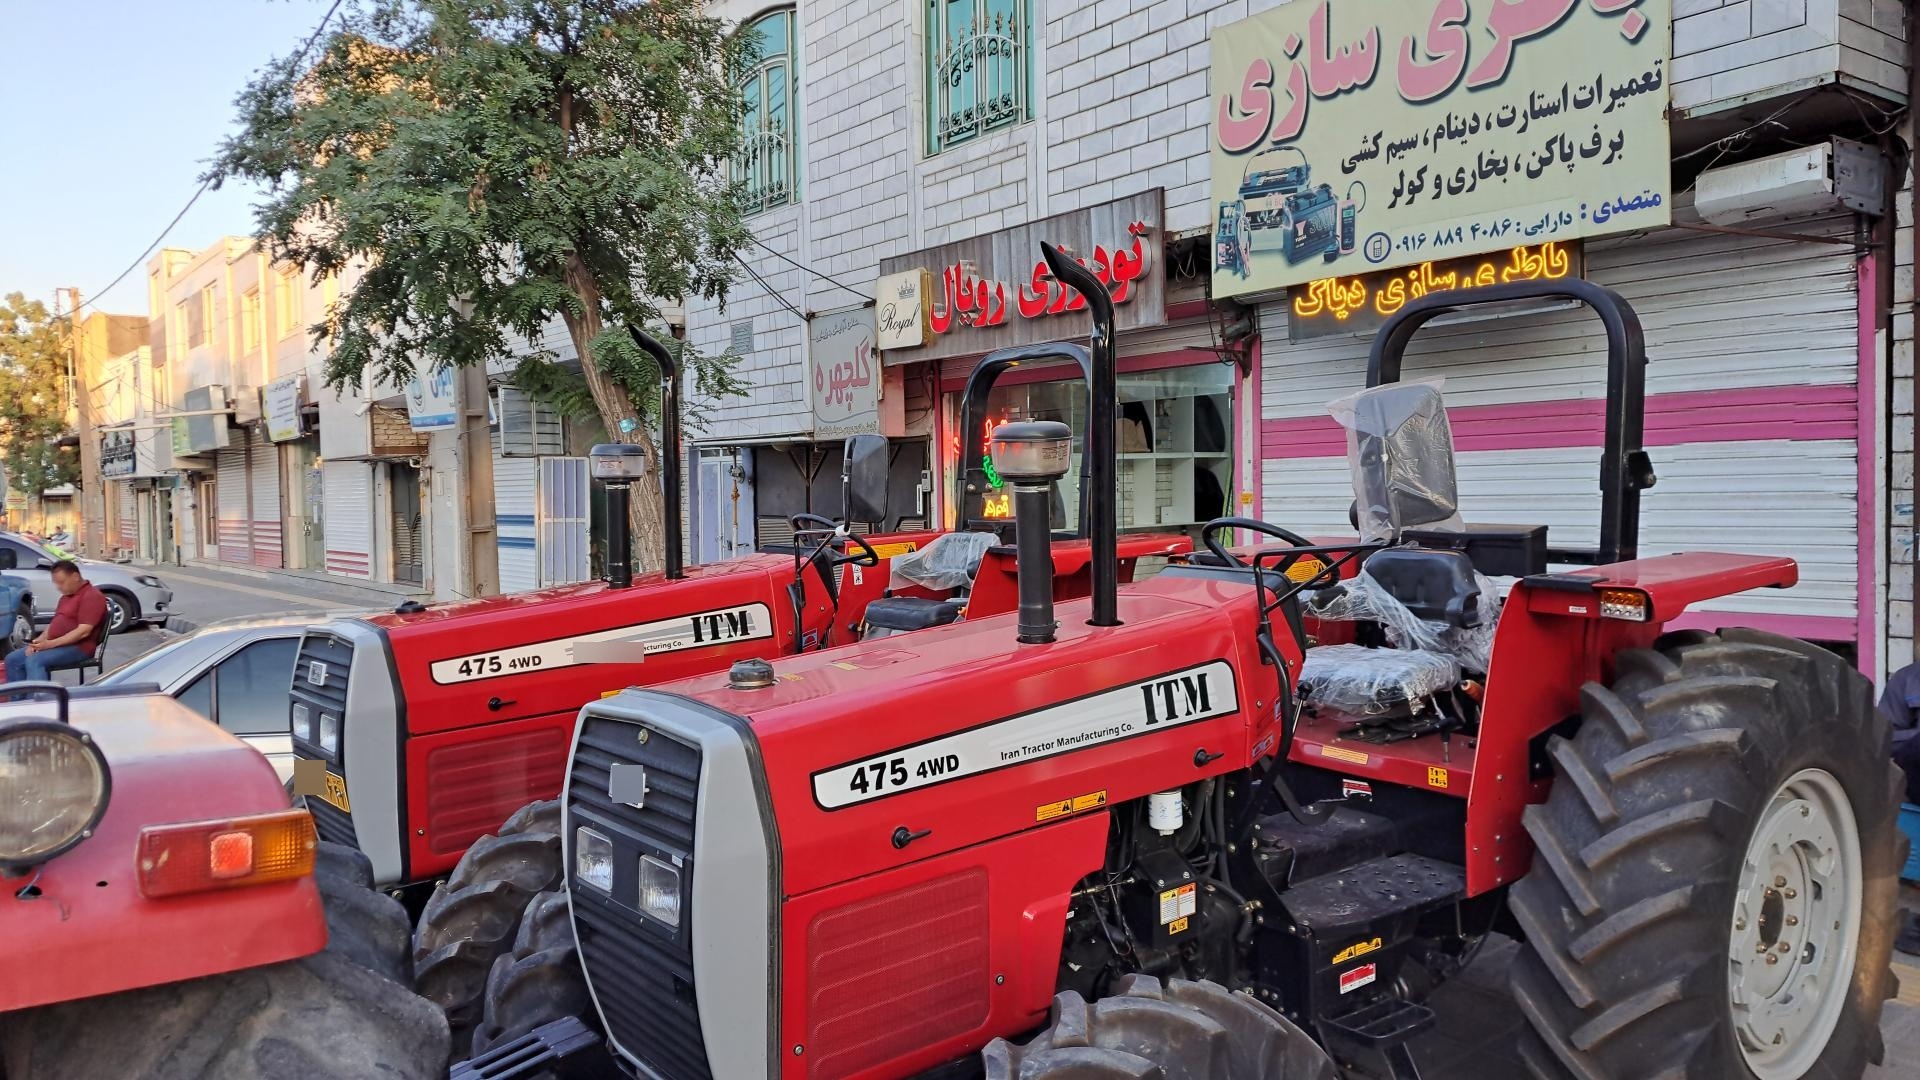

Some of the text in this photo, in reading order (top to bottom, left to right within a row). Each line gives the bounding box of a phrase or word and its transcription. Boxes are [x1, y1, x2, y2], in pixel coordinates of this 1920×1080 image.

[1217, 1, 1381, 153] سازی
[1573, 58, 1663, 114] تعمیرات
[1341, 131, 1383, 175] کشی
[1386, 133, 1419, 164] سیم
[1579, 123, 1625, 165] برف
[1388, 164, 1428, 209] کولر
[1432, 173, 1443, 200] و
[1446, 149, 1509, 197] بخاری
[930, 259, 1006, 334] رویال
[879, 302, 921, 339] Royal
[815, 336, 871, 412] گلچهره
[690, 610, 751, 643] ITM
[457, 654, 542, 677] 475 4WD
[1140, 672, 1213, 726] ITM
[1000, 723, 1134, 761] Iran Tractor Manufacturing Co.
[850, 753, 960, 795] 475 4WD
